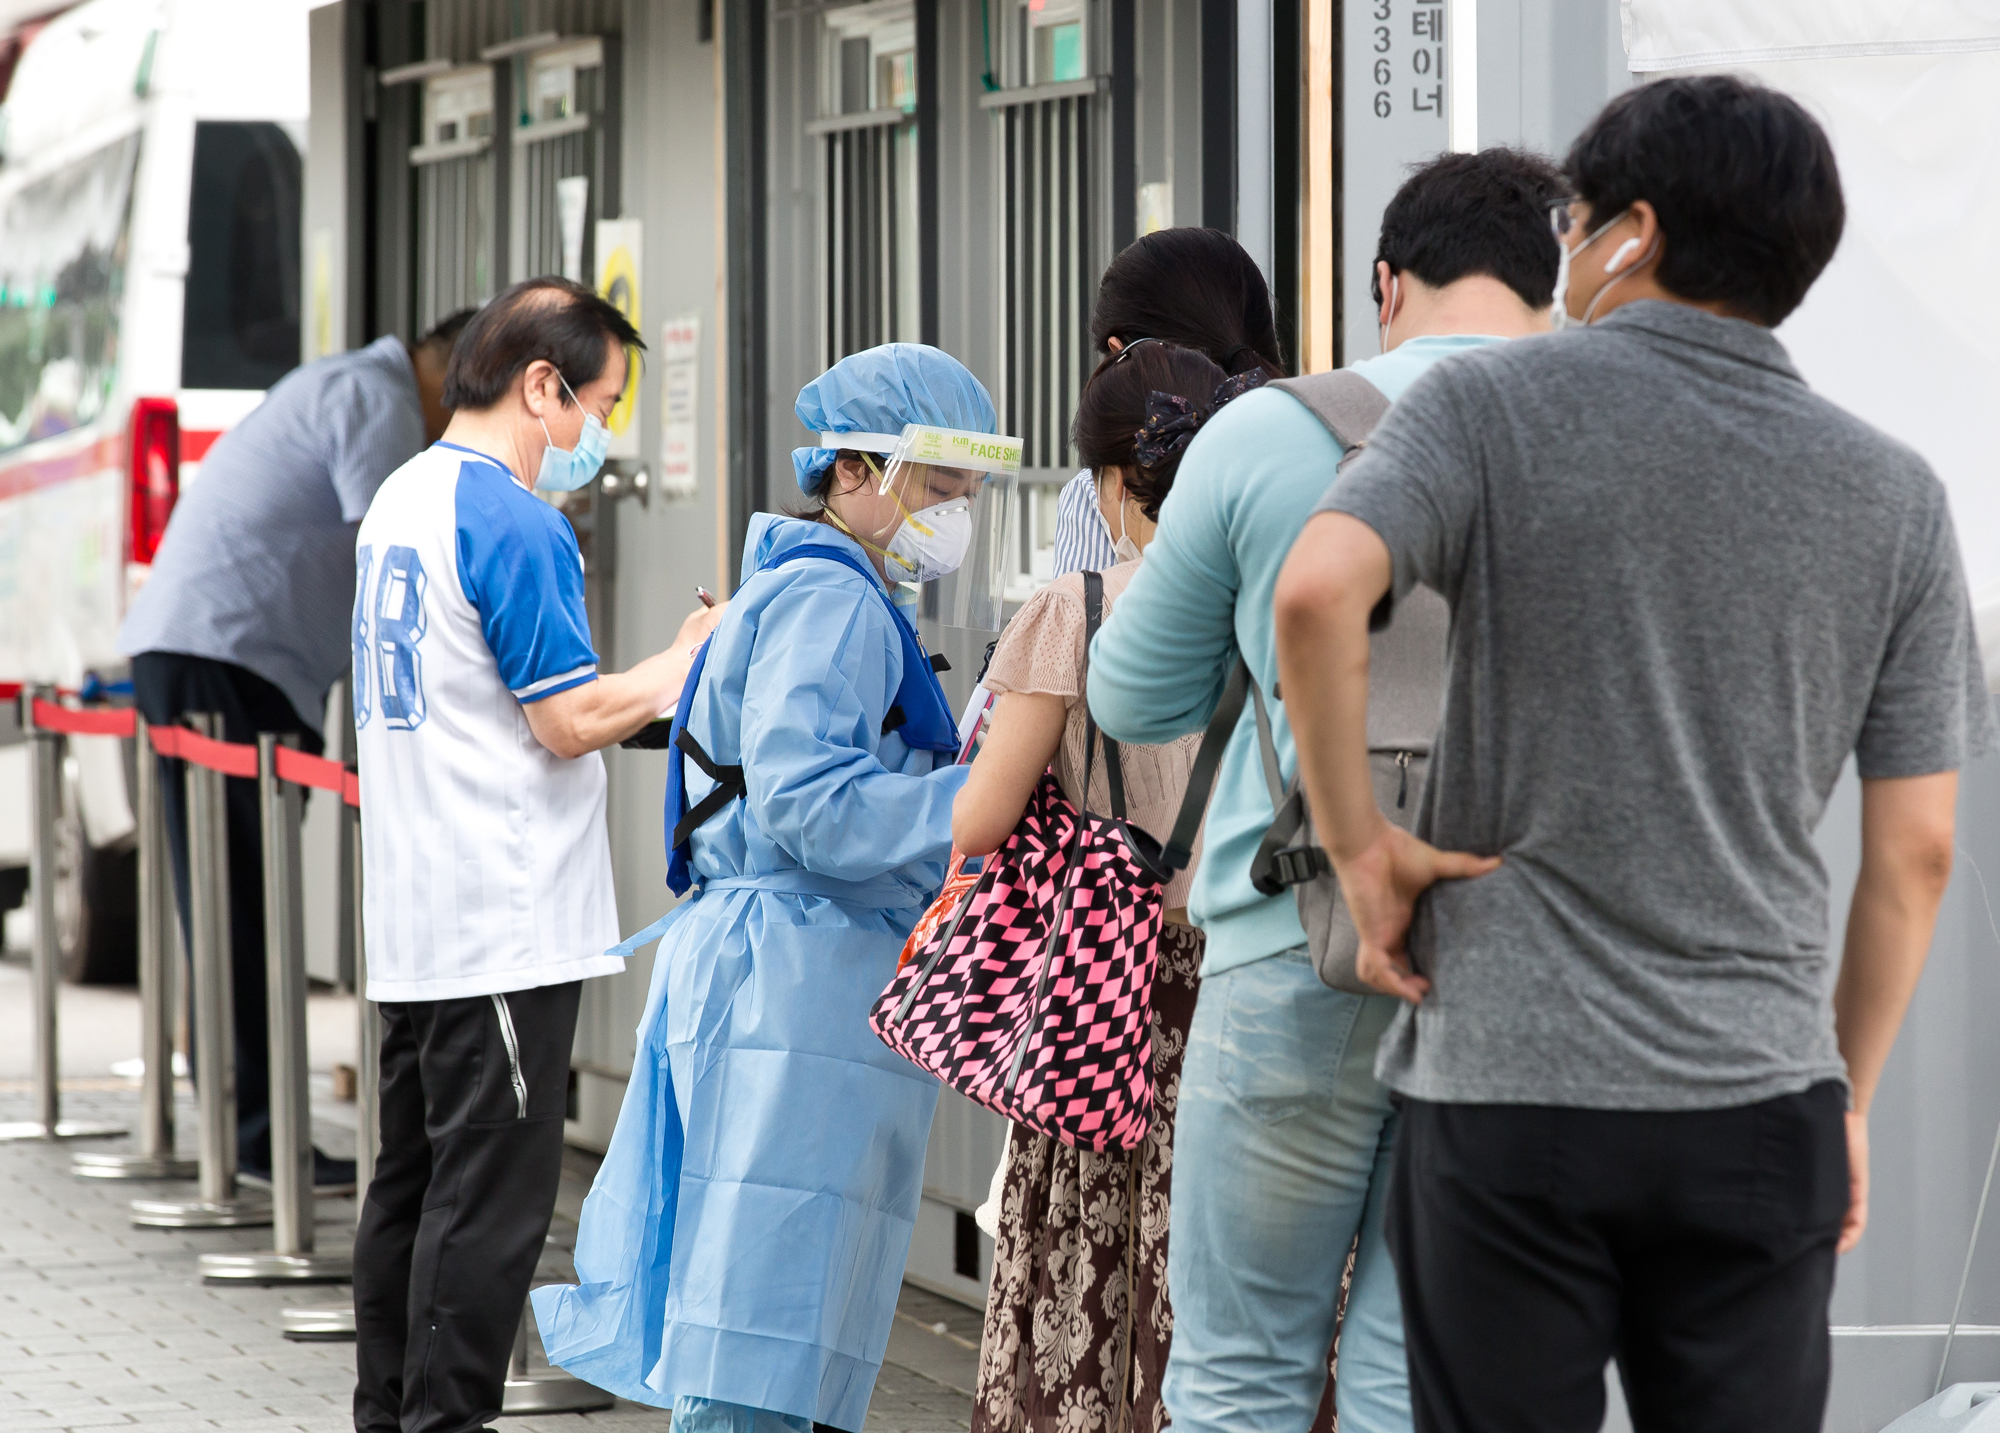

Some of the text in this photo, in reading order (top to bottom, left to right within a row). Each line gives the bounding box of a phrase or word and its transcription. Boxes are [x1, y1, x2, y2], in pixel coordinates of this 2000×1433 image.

[1374, 0, 1391, 118] 3366
[1412, 0, 1442, 118] 테이너
[970, 443, 1002, 460] FACE
